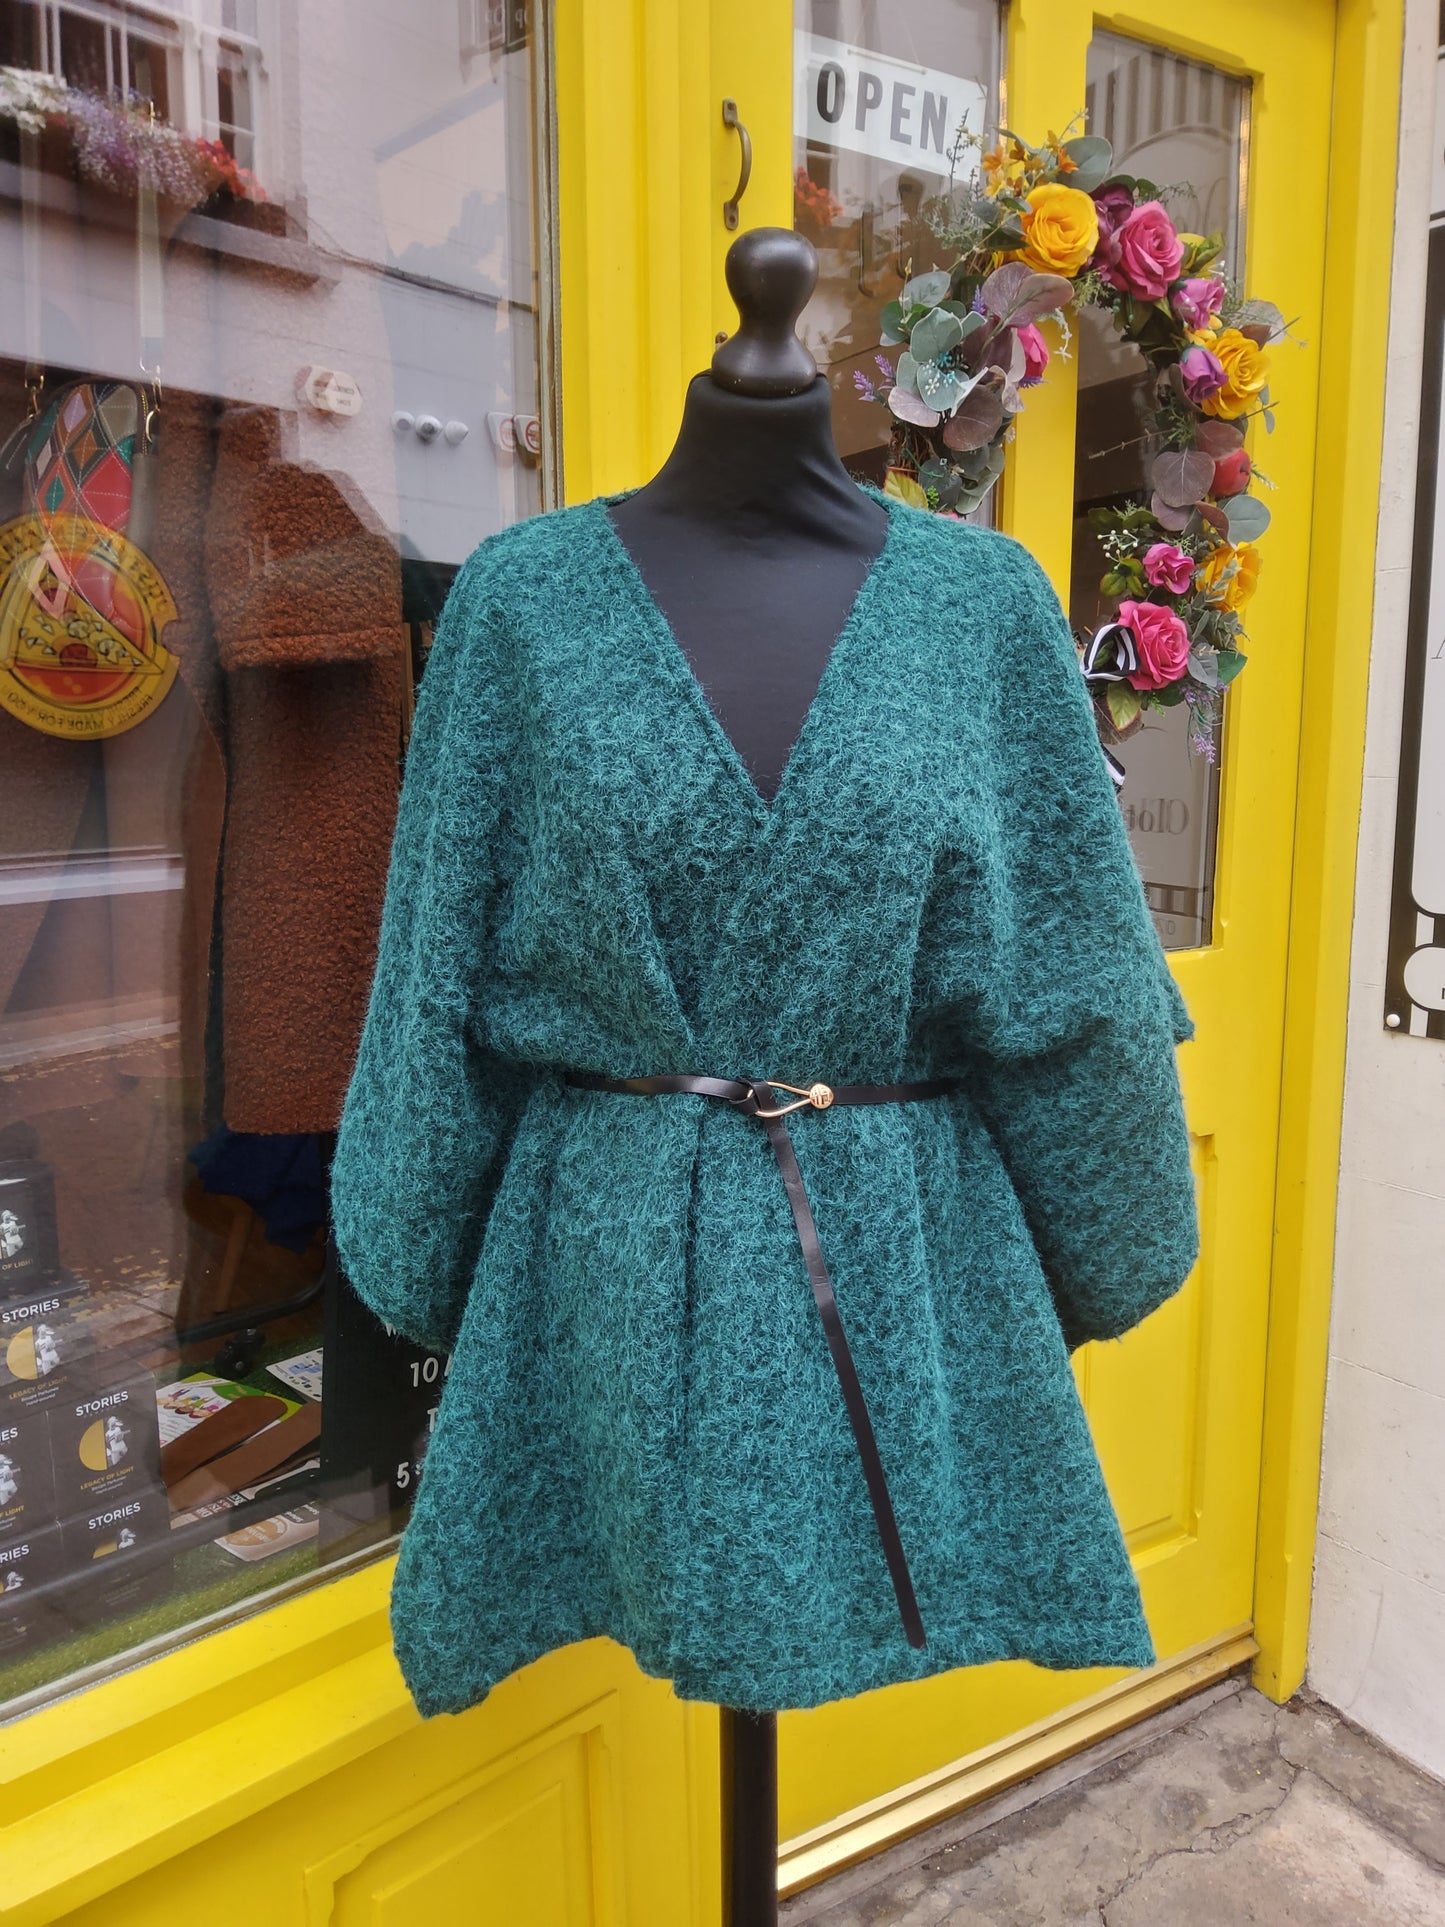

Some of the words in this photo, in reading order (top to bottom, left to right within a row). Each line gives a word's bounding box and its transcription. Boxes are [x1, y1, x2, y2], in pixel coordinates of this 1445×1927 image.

[816, 61, 948, 155] OPEN
[1, 1298, 60, 1324] STORIES
[410, 1357, 439, 1388] 10
[8, 1384, 36, 1400] LEGACY
[37, 1381, 46, 1391] OF
[75, 1390, 129, 1416] STORIES
[80, 1475, 105, 1491] LEGACY
[106, 1472, 116, 1481] OF
[116, 1465, 134, 1477] LIGHT
[5, 1505, 25, 1517] LIGHT
[88, 1502, 141, 1530] STORIES
